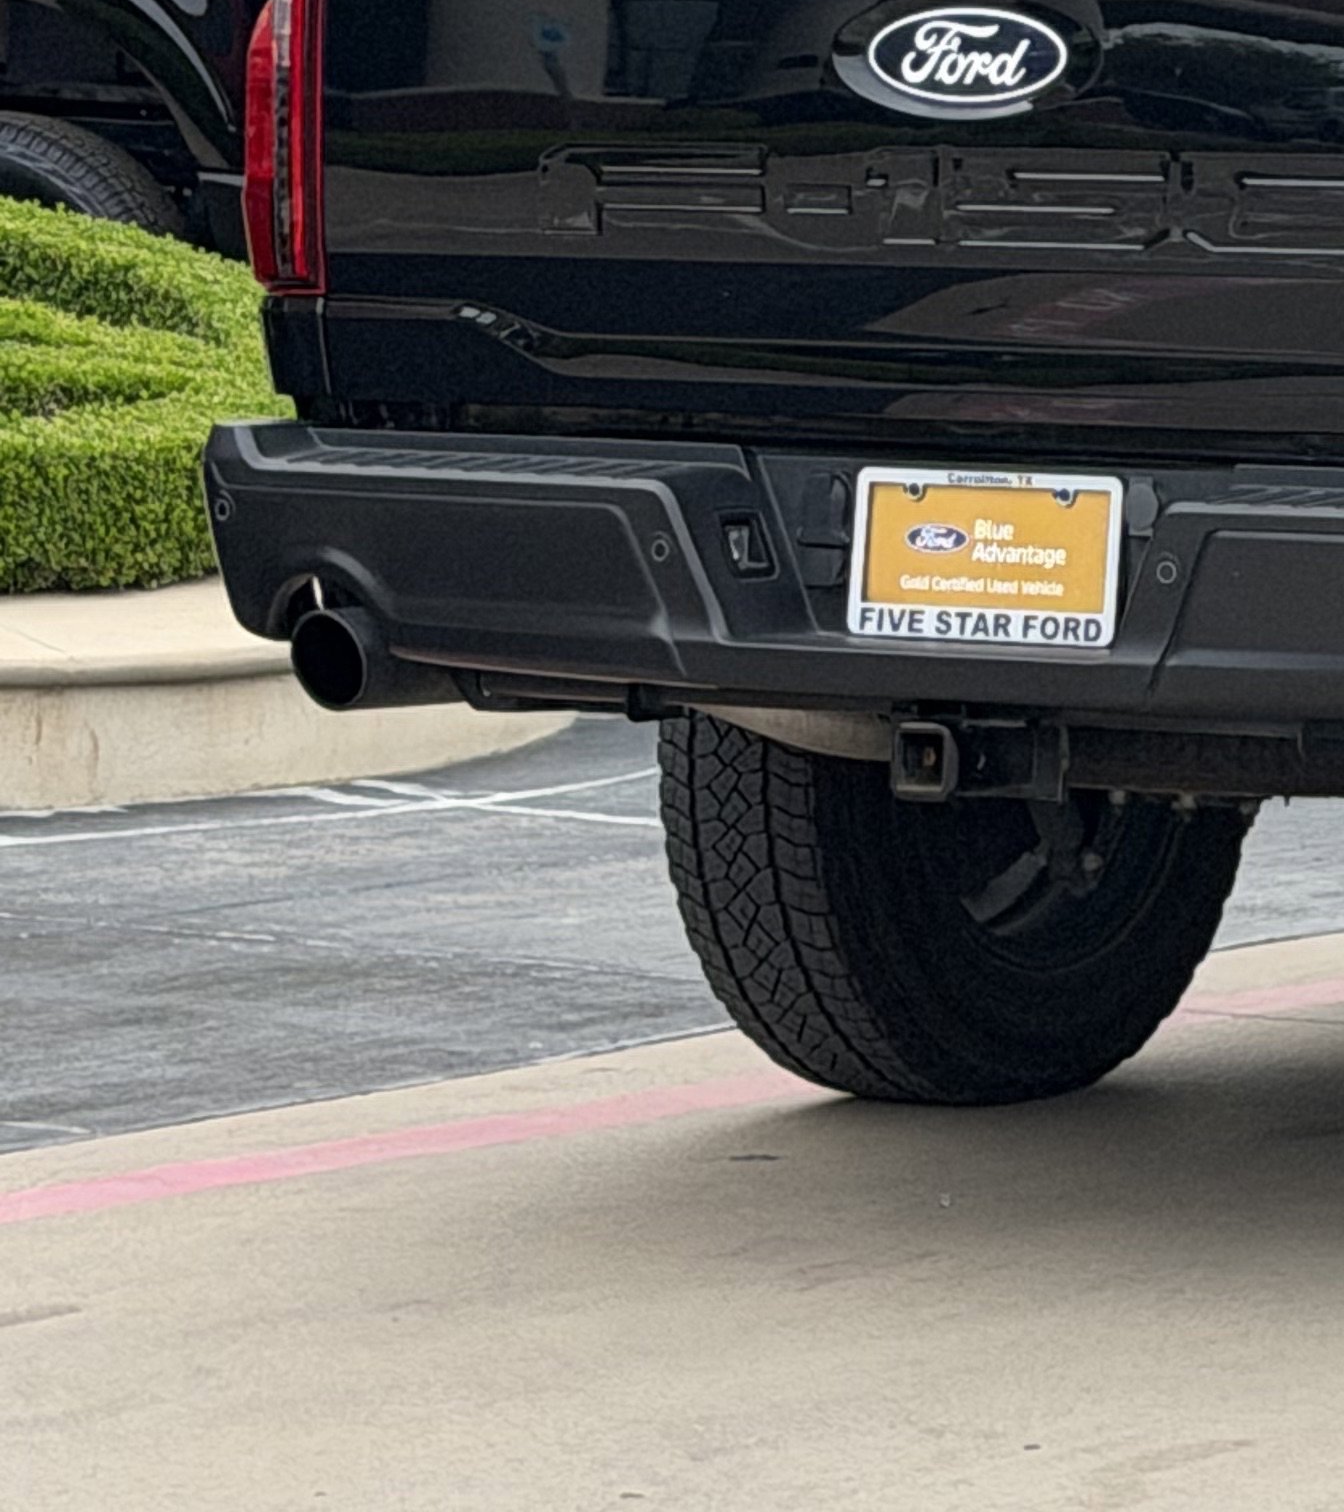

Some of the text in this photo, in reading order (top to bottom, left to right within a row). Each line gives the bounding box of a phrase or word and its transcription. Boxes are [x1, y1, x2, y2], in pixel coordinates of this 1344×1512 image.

[901, 21, 1029, 87] Ford
[914, 526, 958, 549] Ford
[973, 519, 1014, 541] Blue
[971, 542, 1067, 569] Advantage
[899, 574, 1064, 597] Gold Certified Used Vehicle
[859, 607, 1103, 642] FIVE STAR FORD
